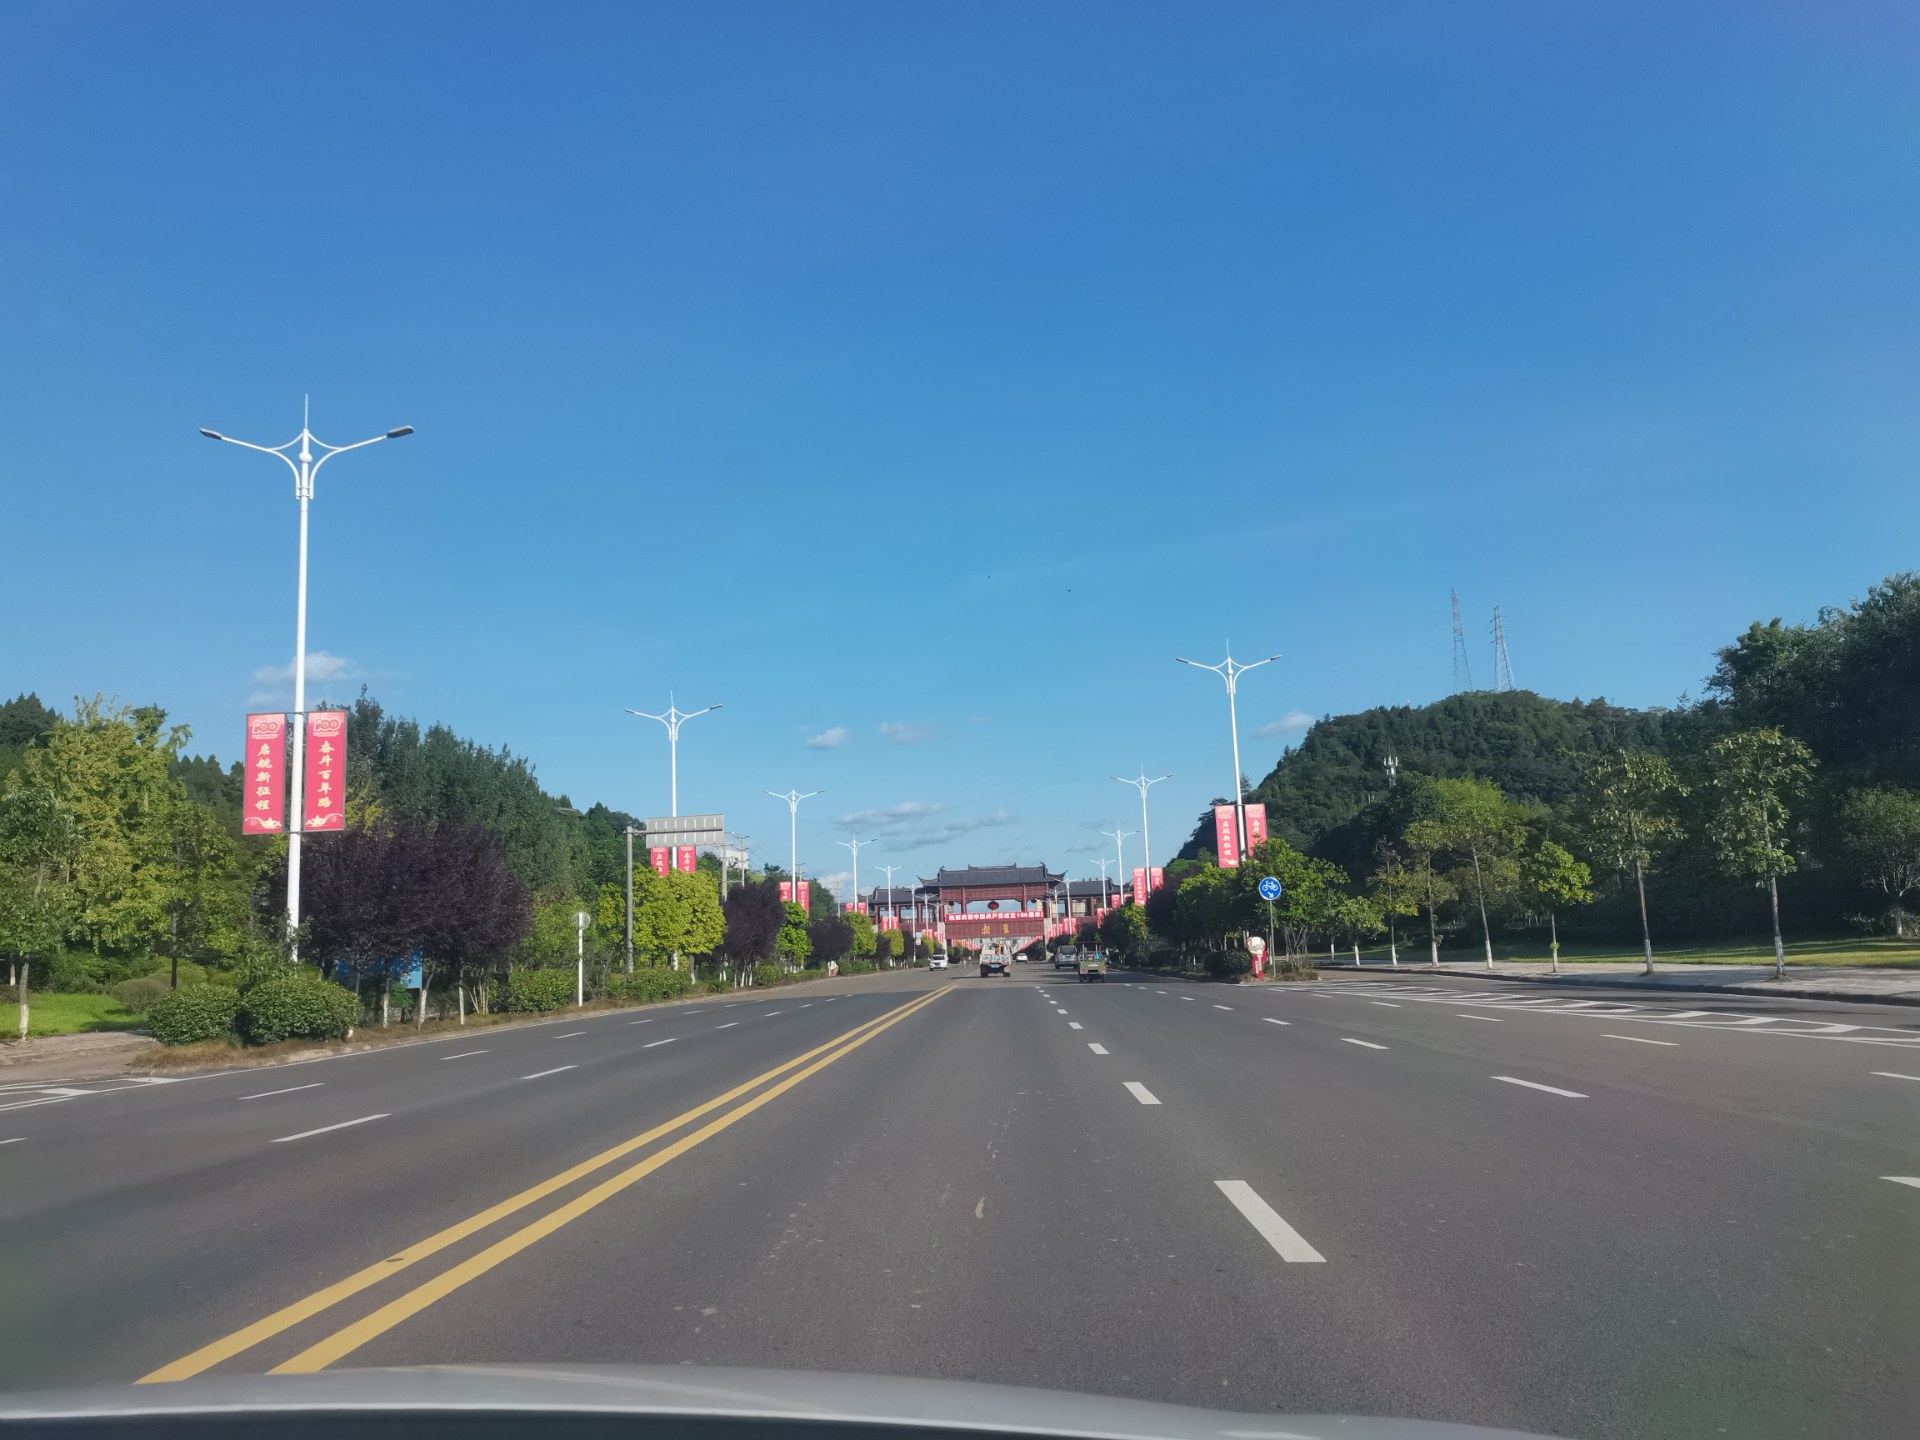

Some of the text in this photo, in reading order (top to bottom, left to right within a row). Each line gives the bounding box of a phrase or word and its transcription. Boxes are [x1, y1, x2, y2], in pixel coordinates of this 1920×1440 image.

[254, 743, 273, 811] 启航新征程
[317, 740, 335, 808] 奋斗百年路
